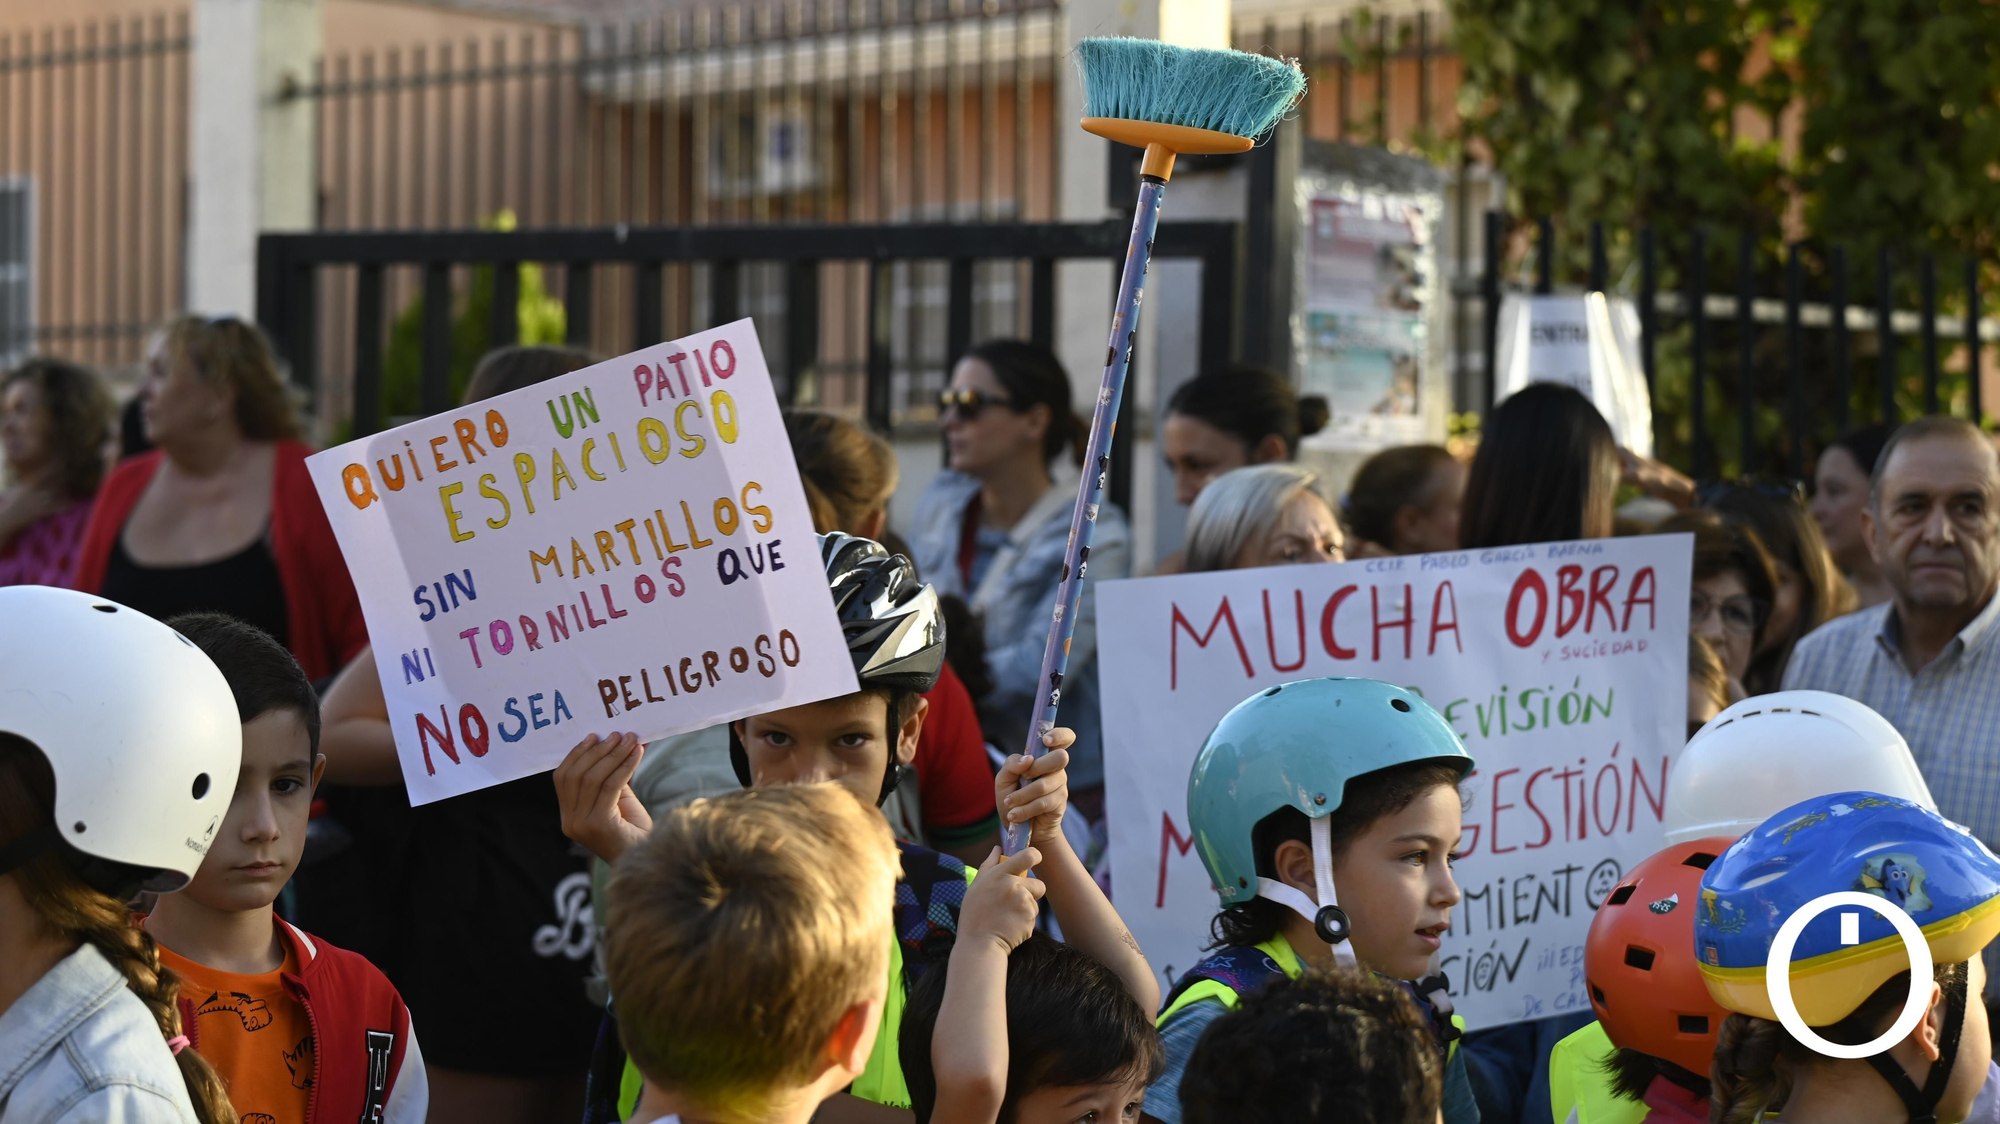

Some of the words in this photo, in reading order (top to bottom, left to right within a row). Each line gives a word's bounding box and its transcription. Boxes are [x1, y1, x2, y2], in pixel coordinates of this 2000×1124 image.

[342, 409, 509, 509] QUIERO
[547, 386, 600, 439] UN
[633, 340, 736, 407] PATIO
[439, 390, 739, 543] ESPACIOSO
[401, 648, 436, 685] NI
[459, 557, 686, 668] TORNILLOS
[717, 539, 785, 586] QUE
[414, 569, 477, 622] SIN
[529, 482, 773, 583] MARTILLOS
[1421, 553, 1469, 571] PABLO
[1547, 543, 1603, 560] BAENA
[1170, 579, 1463, 690] MUCHA
[1505, 564, 1656, 648] OBRA
[415, 703, 490, 776] NO
[498, 690, 573, 742] SEA
[598, 629, 801, 718] PELIGROSO
[1405, 675, 1614, 740] EVISIÓN
[1553, 989, 1592, 1010] CAL
